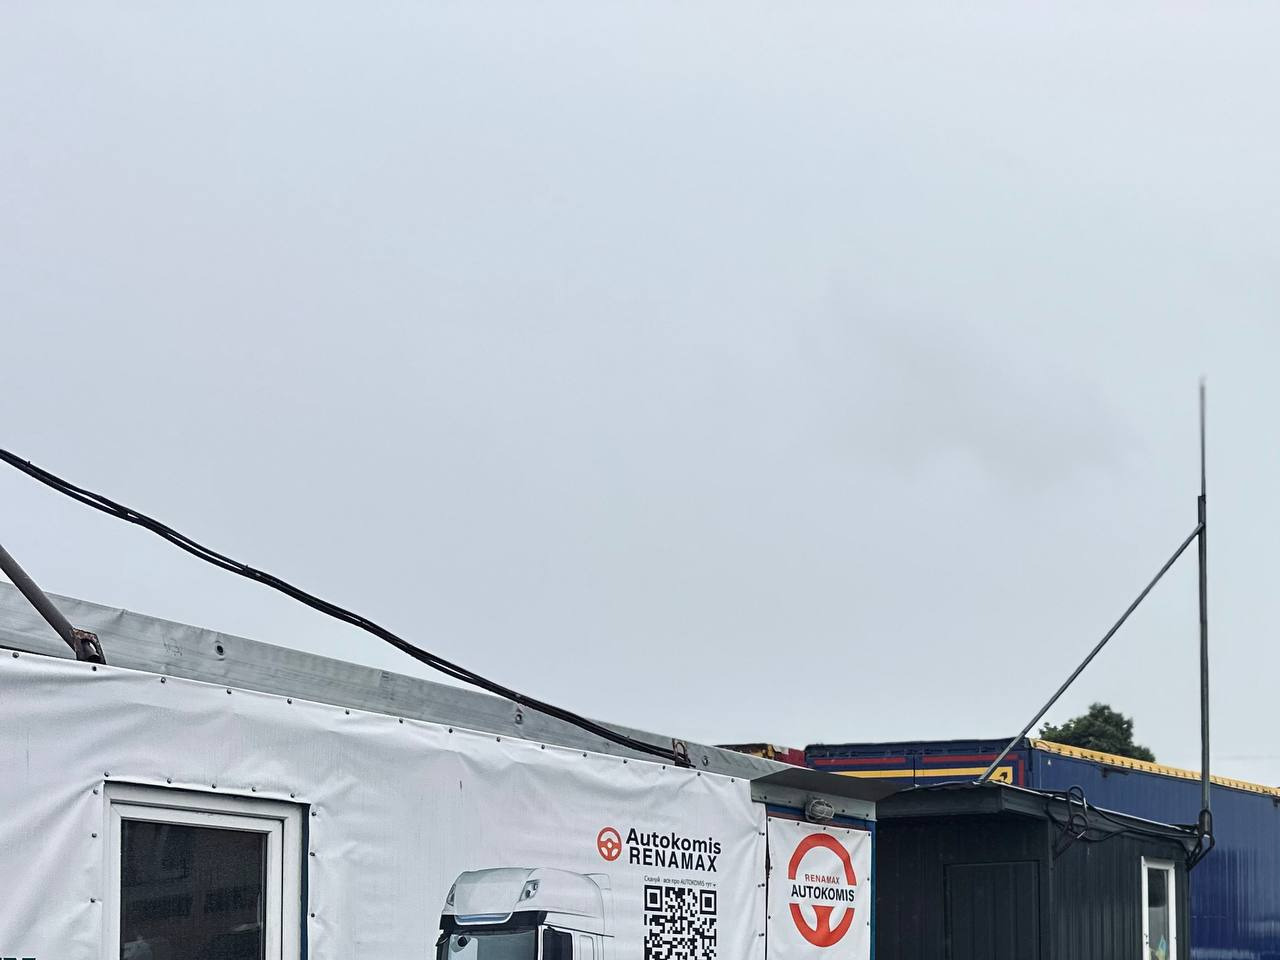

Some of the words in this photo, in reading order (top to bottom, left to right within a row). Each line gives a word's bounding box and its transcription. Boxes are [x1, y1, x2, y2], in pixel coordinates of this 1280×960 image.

[626, 828, 721, 854] Autokomis
[629, 846, 717, 872] RENAMAX
[804, 873, 840, 885] RENAMAX
[791, 884, 855, 902] AUTOKOMIS
